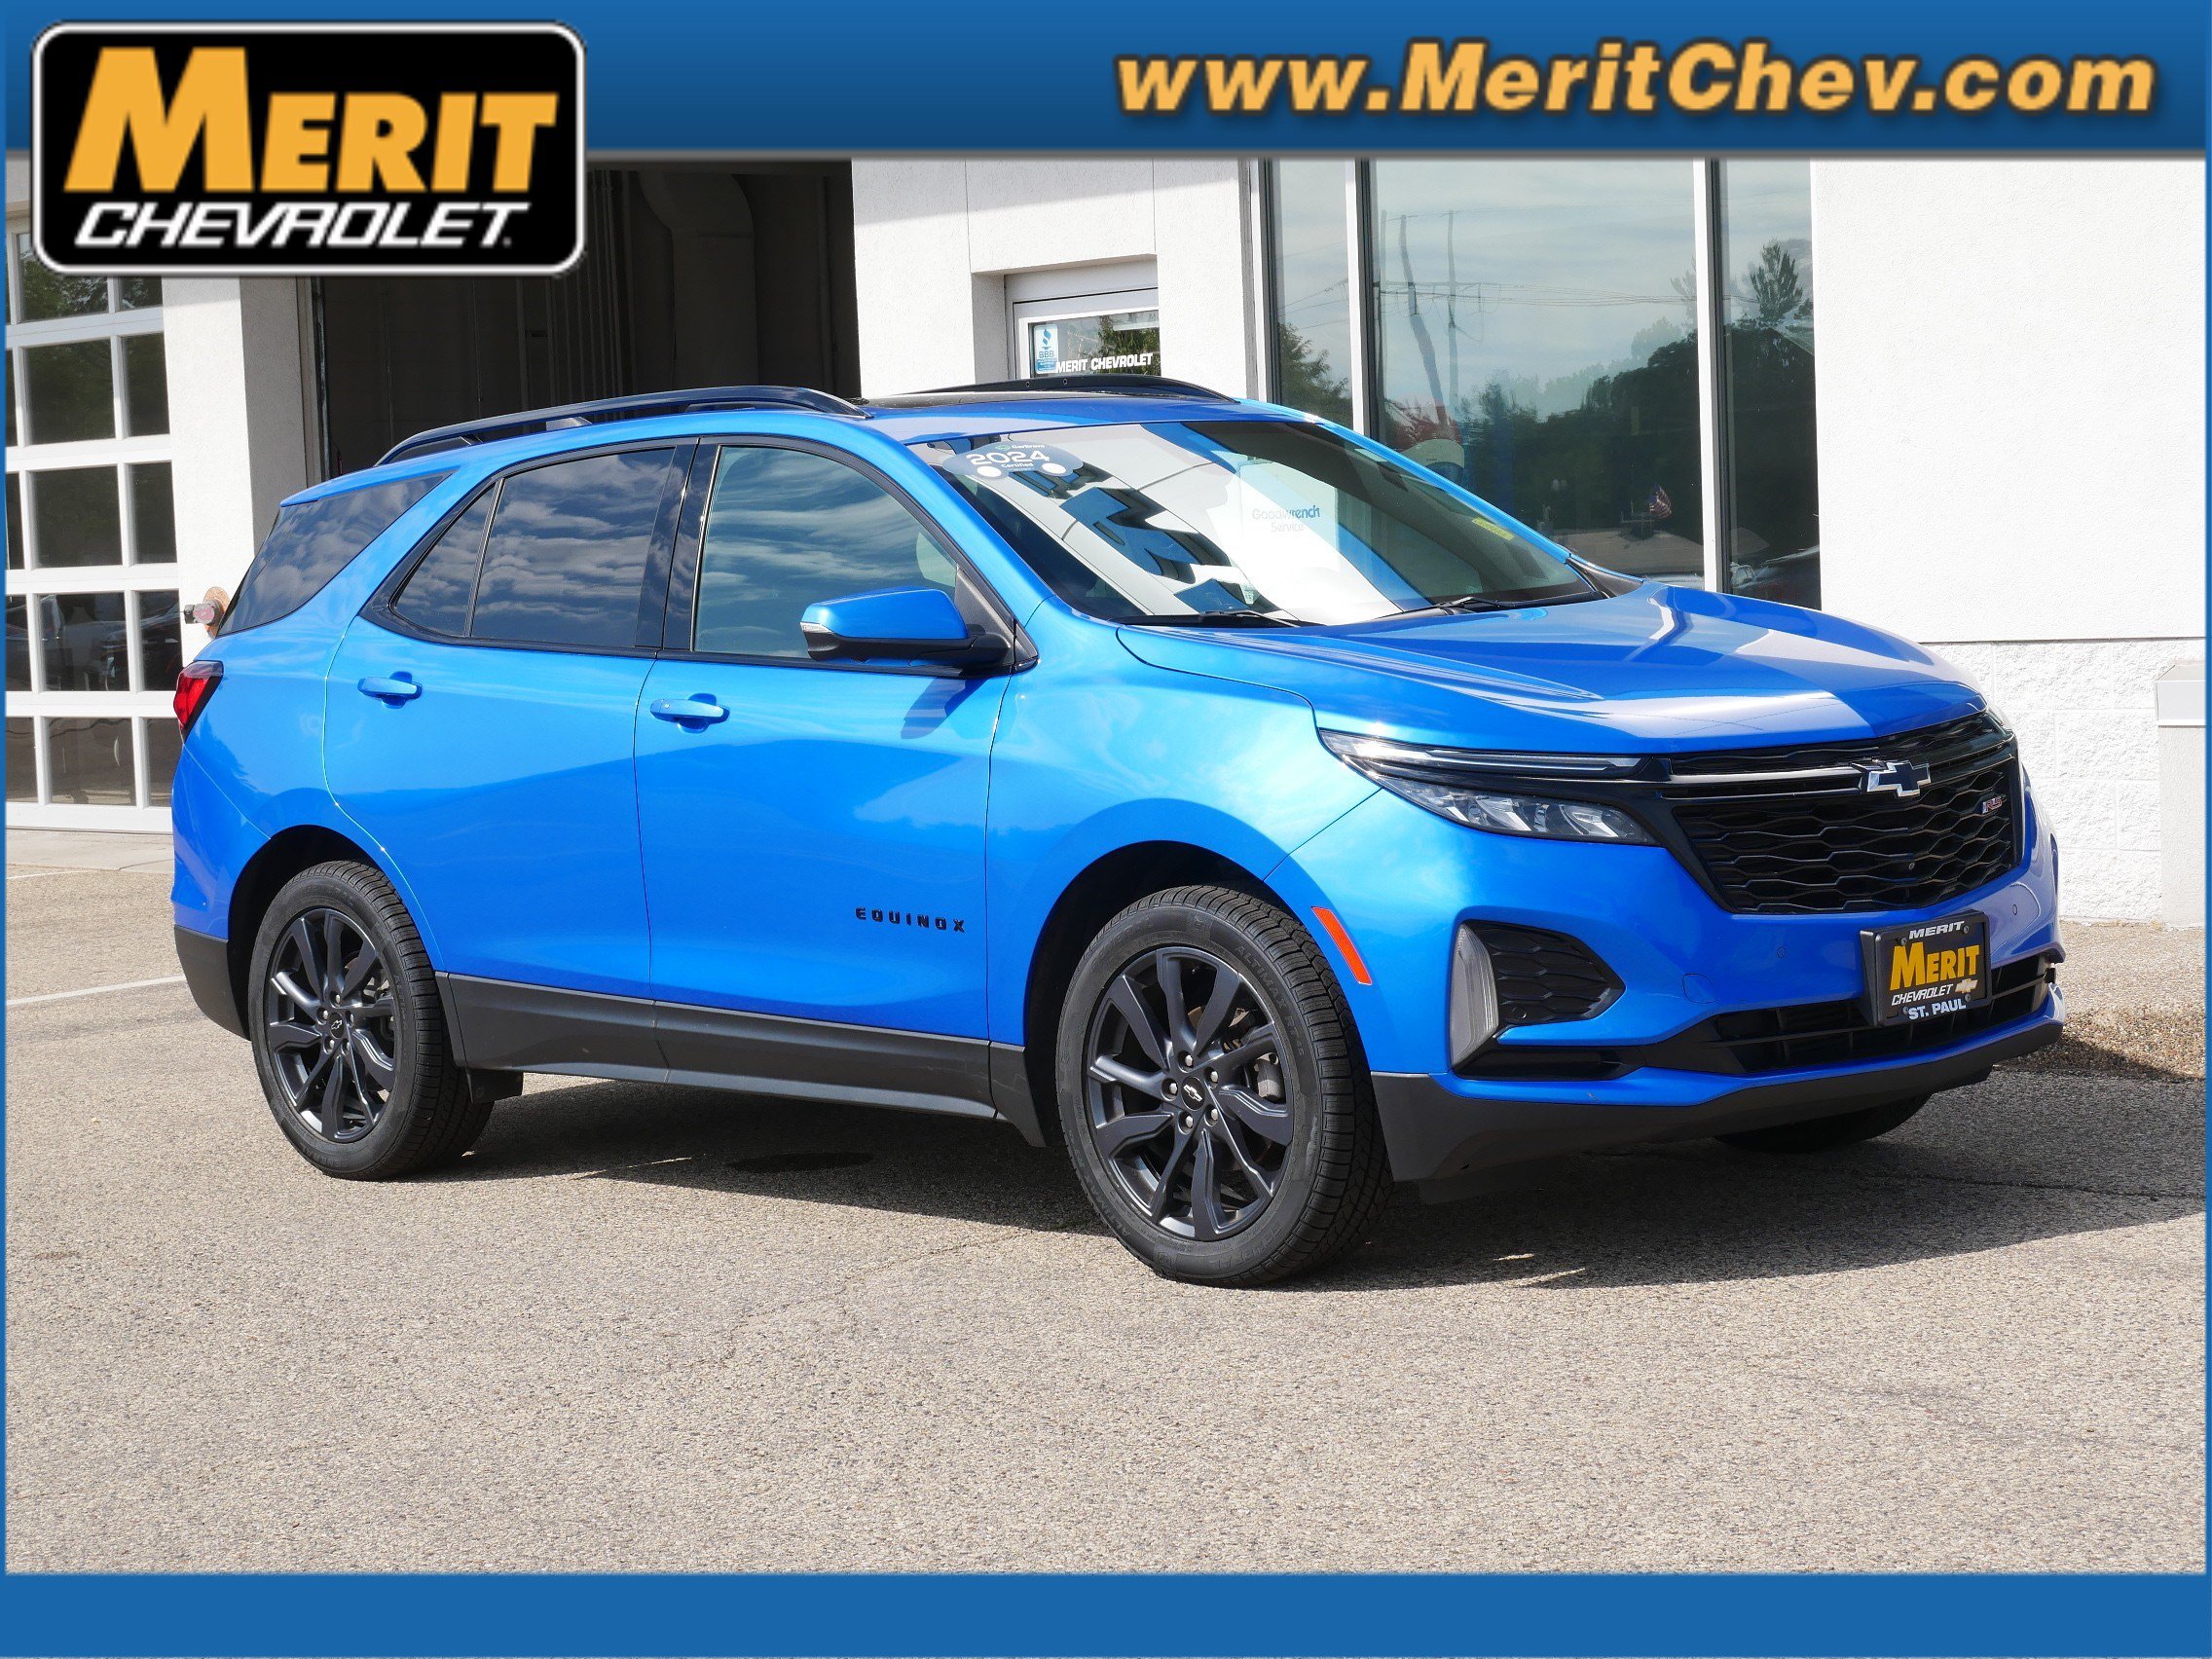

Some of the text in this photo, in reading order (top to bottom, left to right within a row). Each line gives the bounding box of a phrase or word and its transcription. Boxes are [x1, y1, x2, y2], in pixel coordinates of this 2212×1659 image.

[1038, 350, 1054, 358] BBB
[1056, 358, 1088, 374] MERIT
[1090, 352, 1154, 372] CHEVROLET
[966, 450, 1051, 465] 2024
[1252, 505, 1320, 520] Goodwrench
[1271, 522, 1305, 533] Service
[855, 906, 965, 933] EQUINOX
[1908, 920, 1965, 940] MERIT
[1890, 940, 1980, 991] MERIT
[1891, 983, 1954, 1007] CHEVROLET
[1908, 998, 1967, 1020] ST. PAUL
